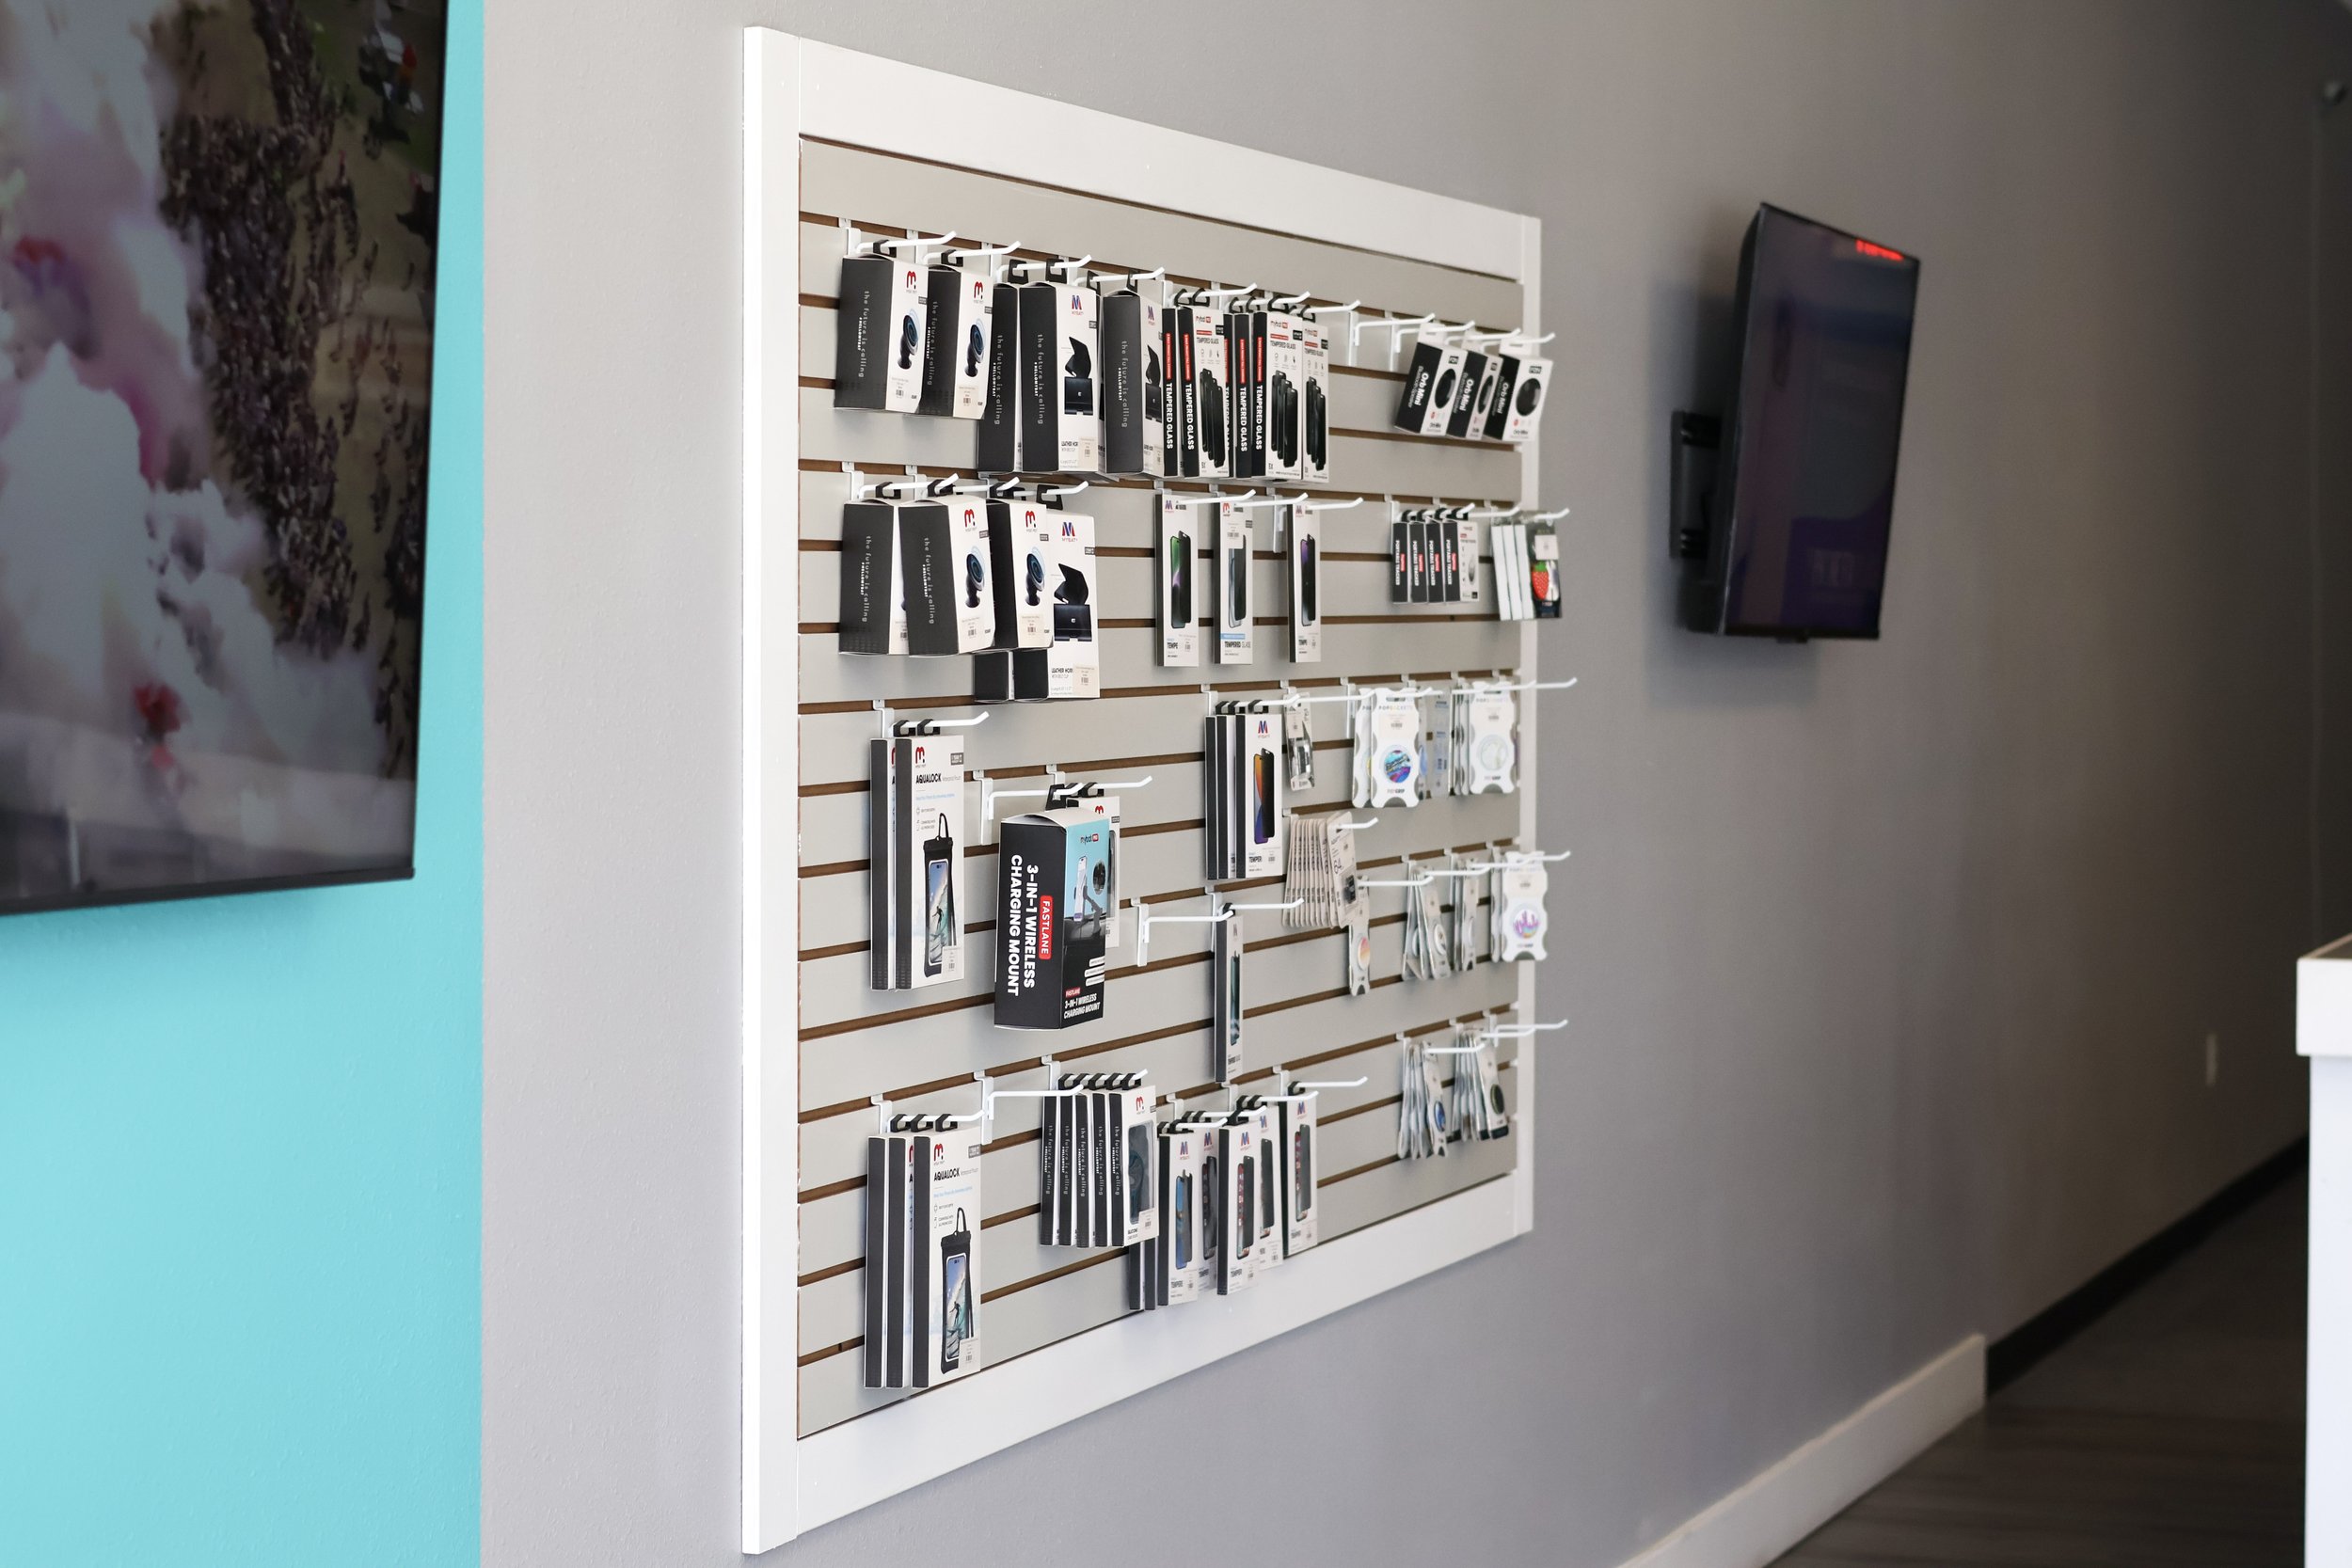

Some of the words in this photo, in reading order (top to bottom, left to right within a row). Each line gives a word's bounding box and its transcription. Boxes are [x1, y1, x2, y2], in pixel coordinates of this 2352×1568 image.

[858, 348, 866, 377] calling
[927, 356, 935, 385] calling
[1418, 372, 1429, 388] Orb
[1463, 377, 1474, 394] Orb
[1500, 381, 1509, 397] Orb
[993, 394, 1002, 424] calling
[1184, 383, 1193, 423] TEMPERED
[1413, 388, 1425, 405] Mini
[1458, 393, 1470, 411] Mini
[1496, 397, 1506, 414] Mini
[1120, 398, 1129, 427] calling
[861, 593, 869, 622] calling
[927, 594, 935, 624] calling
[1009, 854, 1023, 936] CHARGING
[1025, 864, 1039, 912] 3-IN-1
[1040, 900, 1051, 954] FASTLANE
[1023, 915, 1037, 988] WIRELESS
[1007, 939, 1020, 996] MOUNT
[1064, 1006, 1086, 1019] CHARGING
[1085, 1001, 1101, 1013] MOUNT
